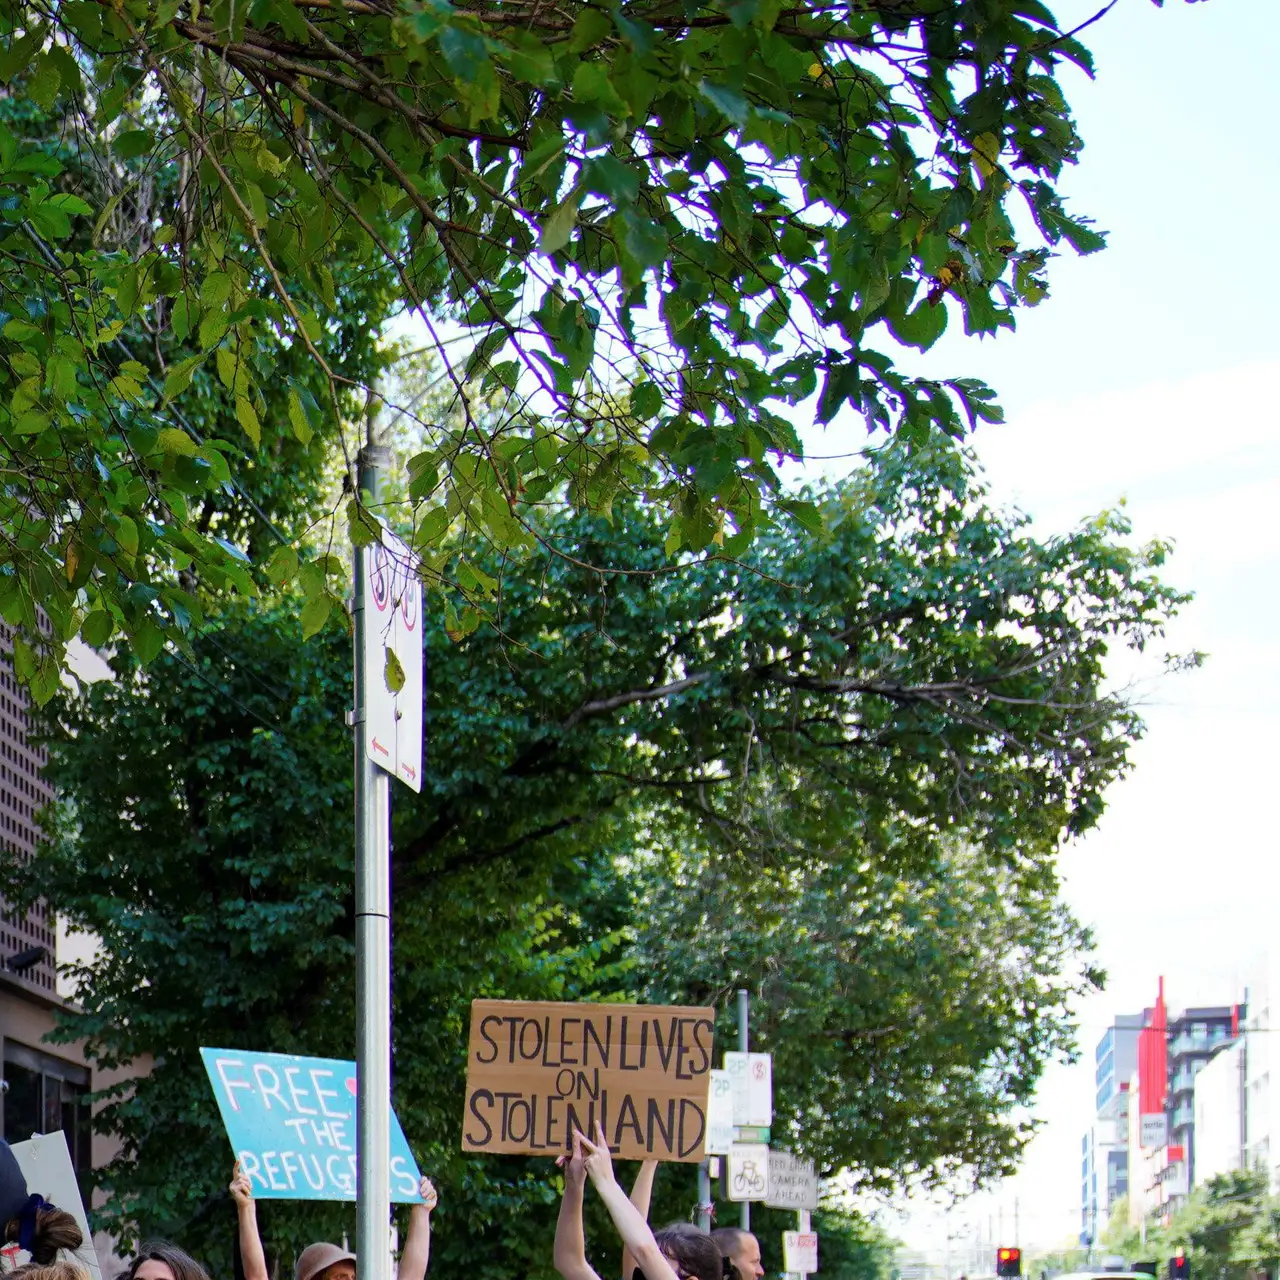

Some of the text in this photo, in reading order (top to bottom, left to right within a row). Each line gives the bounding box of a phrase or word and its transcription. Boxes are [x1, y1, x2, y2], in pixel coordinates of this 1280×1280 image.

[475, 1014, 715, 1080] STOLEN LIVES
[215, 1058, 351, 1120] FREE
[555, 1067, 600, 1101] ON
[284, 1118, 352, 1151] THE
[465, 1088, 706, 1159] STOLEN LAND
[238, 1151, 418, 1196] REFUGS
[771, 1174, 810, 1187] CAMERA
[775, 1191, 807, 1202] AHEAD
